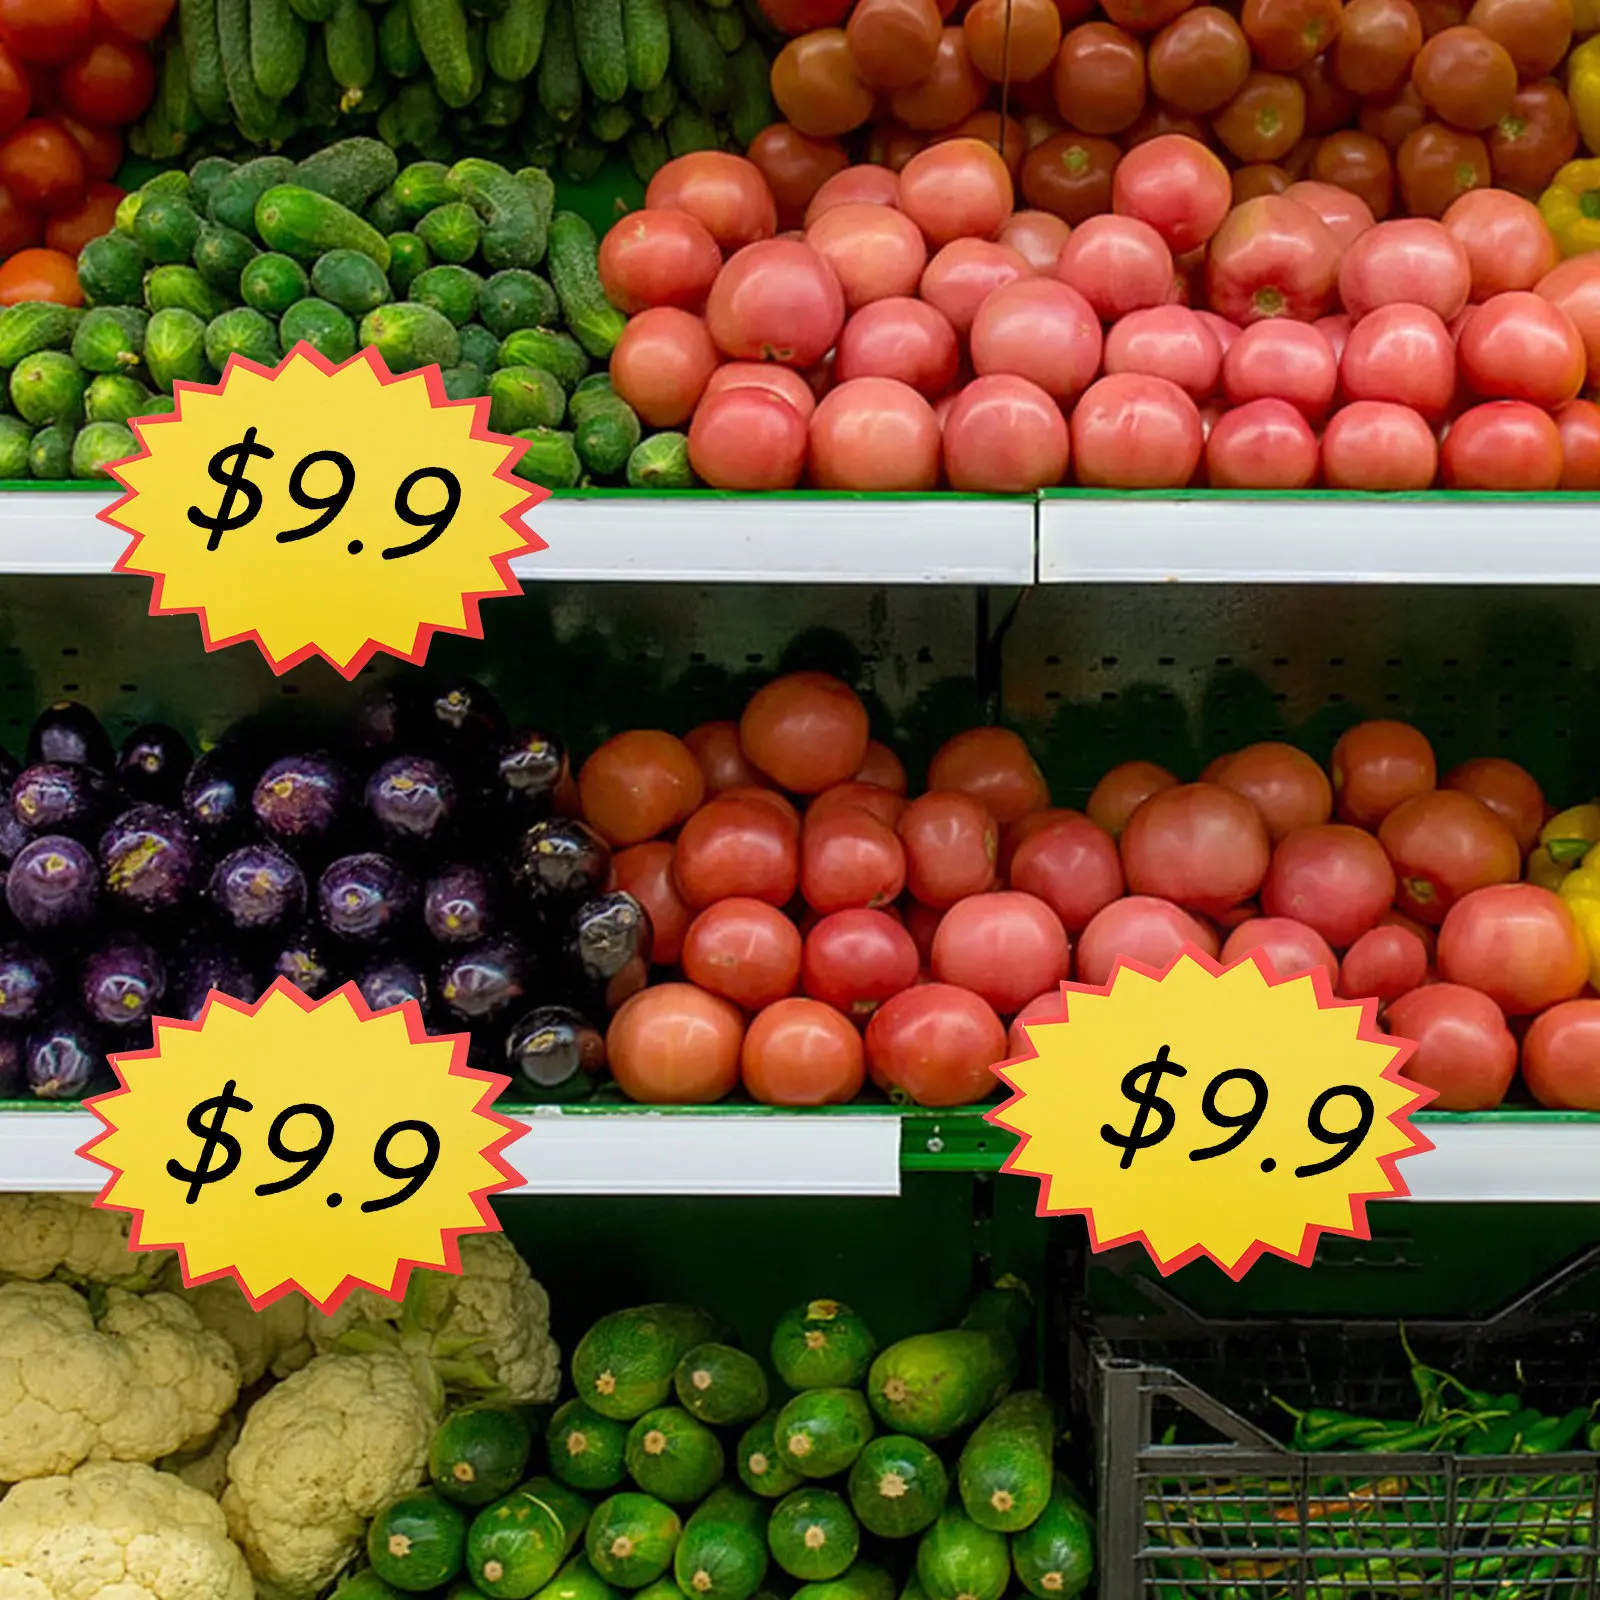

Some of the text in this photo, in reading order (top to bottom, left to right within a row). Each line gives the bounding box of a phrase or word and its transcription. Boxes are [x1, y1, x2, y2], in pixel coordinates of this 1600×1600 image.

[188, 427, 461, 560] $9.9
[167, 1080, 440, 1213] $9.9
[1101, 1045, 1374, 1178] $9.9
